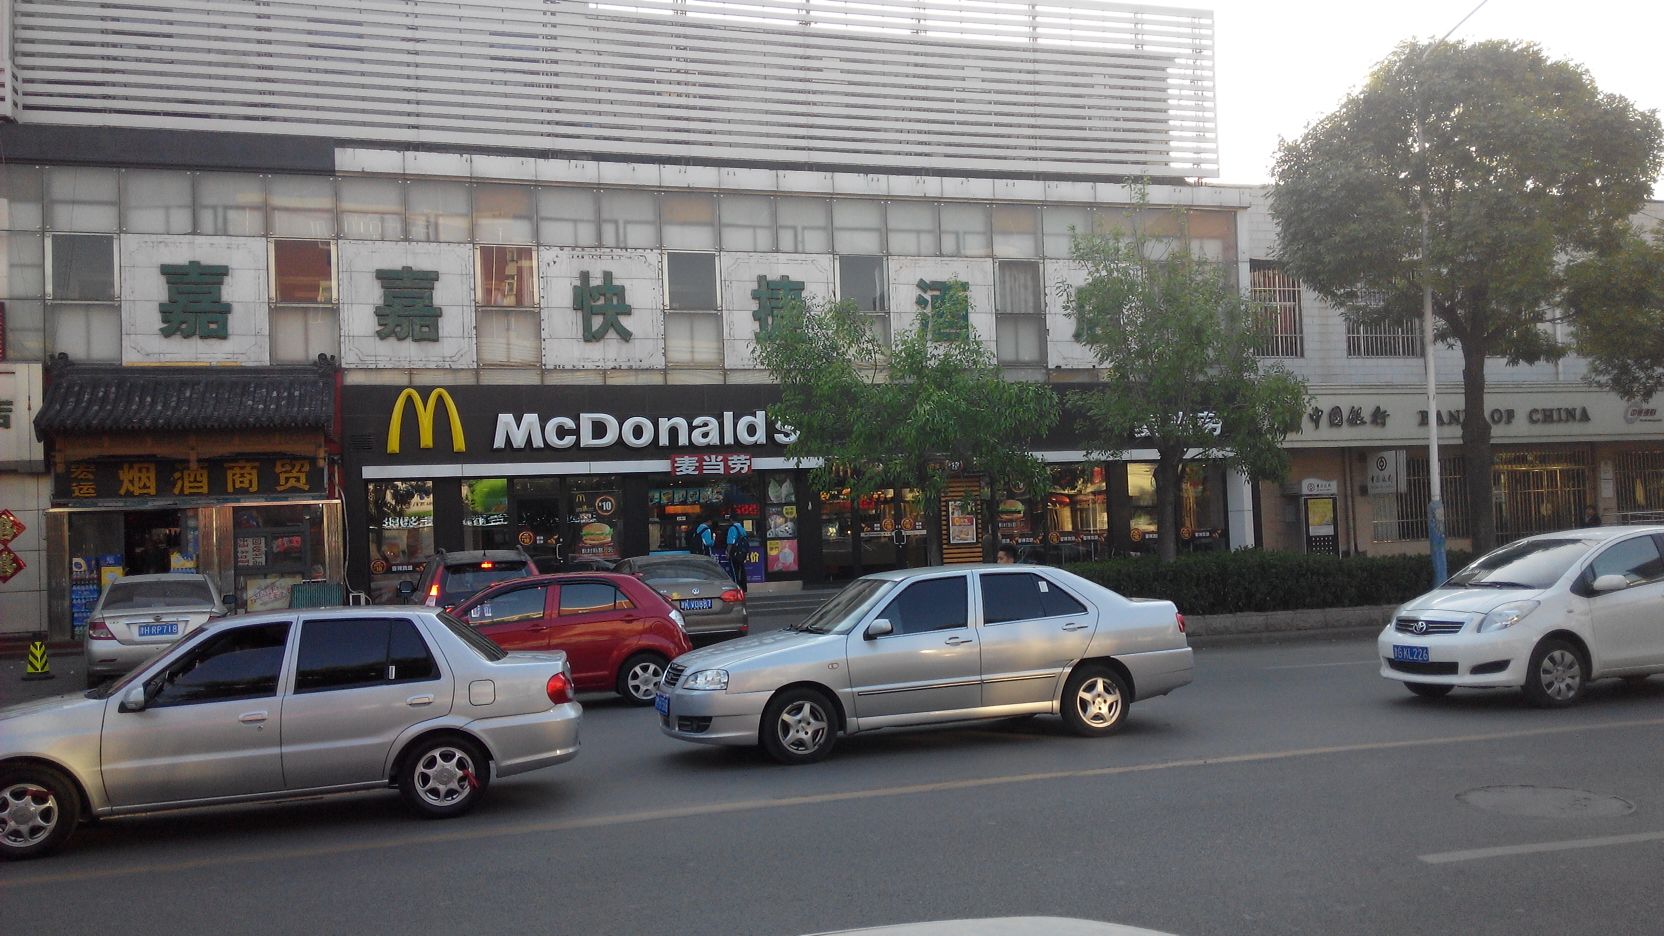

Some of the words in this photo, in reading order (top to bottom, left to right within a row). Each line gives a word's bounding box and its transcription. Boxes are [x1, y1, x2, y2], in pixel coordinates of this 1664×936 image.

[1309, 406, 1390, 429] 中国银行
[1417, 409, 1468, 426] BAN
[1490, 408, 1516, 425] OF
[1528, 407, 1592, 425] CHINA
[493, 411, 801, 449] McDonalds
[674, 455, 752, 475] 麦当劳
[118, 460, 311, 497] 烟酒商贸
